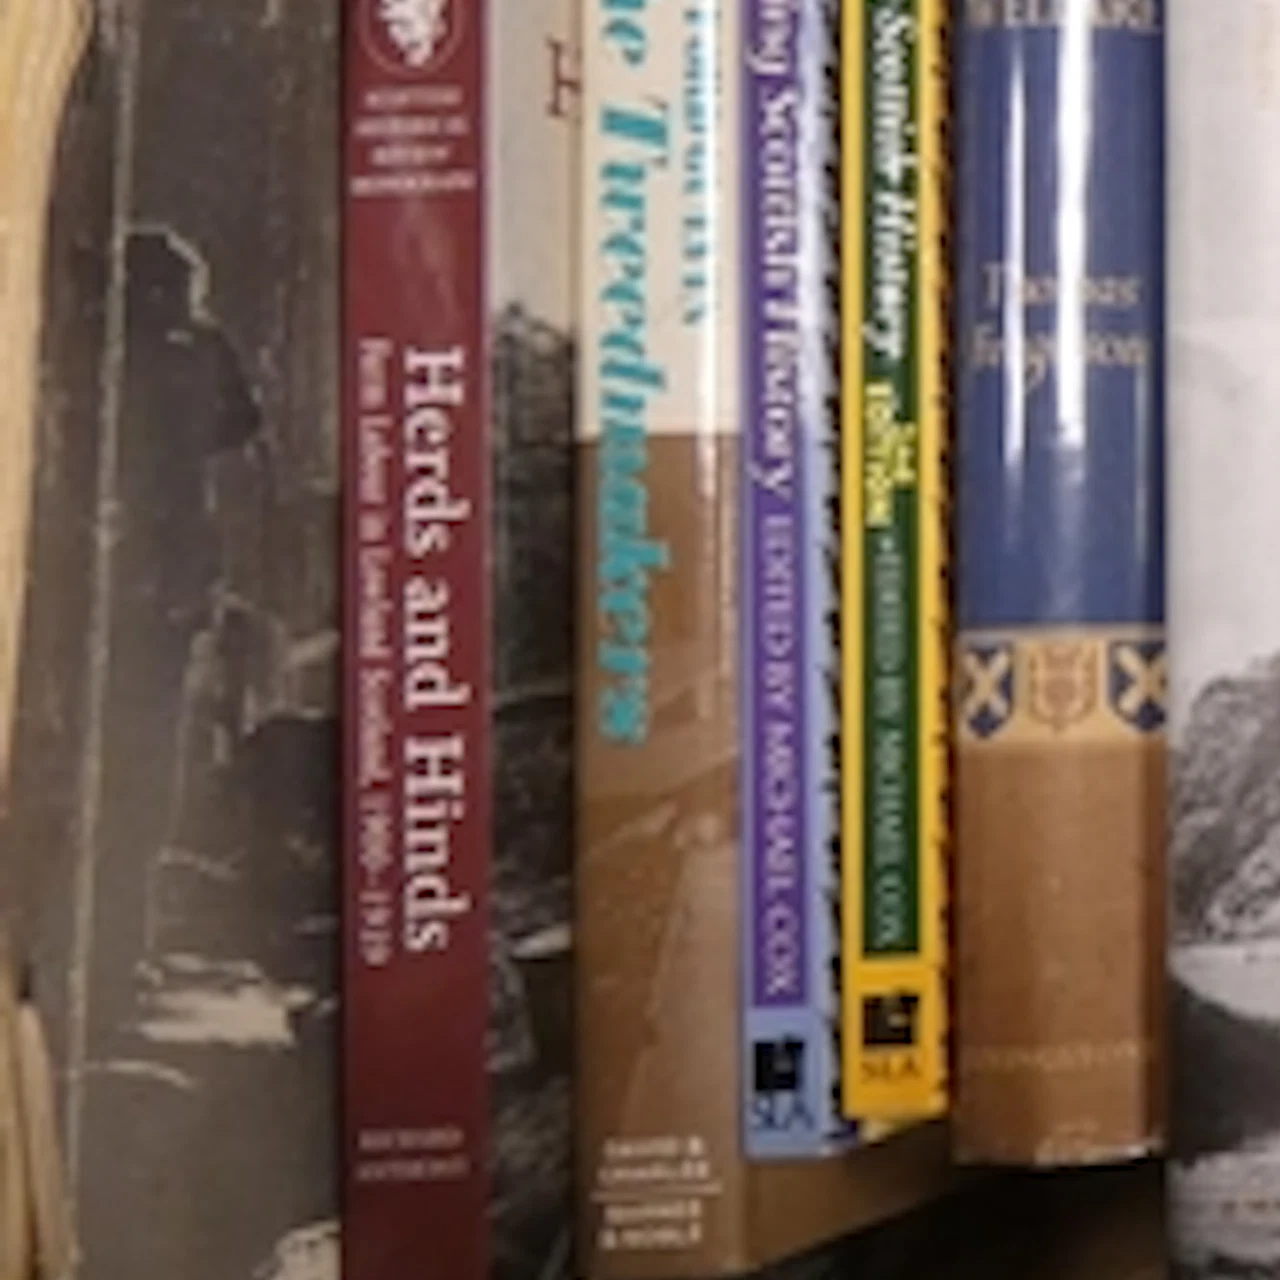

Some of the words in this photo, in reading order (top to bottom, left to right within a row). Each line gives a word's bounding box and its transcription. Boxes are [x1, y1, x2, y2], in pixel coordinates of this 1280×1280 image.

[874, 7, 917, 186] Scottish
[761, 86, 799, 285] Scottish
[862, 190, 918, 359] History
[403, 345, 474, 558] Herds
[601, 98, 672, 744] Tweedmakers
[747, 298, 799, 499] History
[359, 547, 393, 659] Lowland
[403, 576, 472, 711] and
[763, 515, 798, 659] EDITED
[763, 662, 798, 710] BY
[403, 733, 473, 953] Hinds
[763, 721, 798, 891] MICHAEL
[875, 728, 906, 868] MICHAEL
[763, 901, 798, 996] COX
[875, 879, 906, 946] COX
